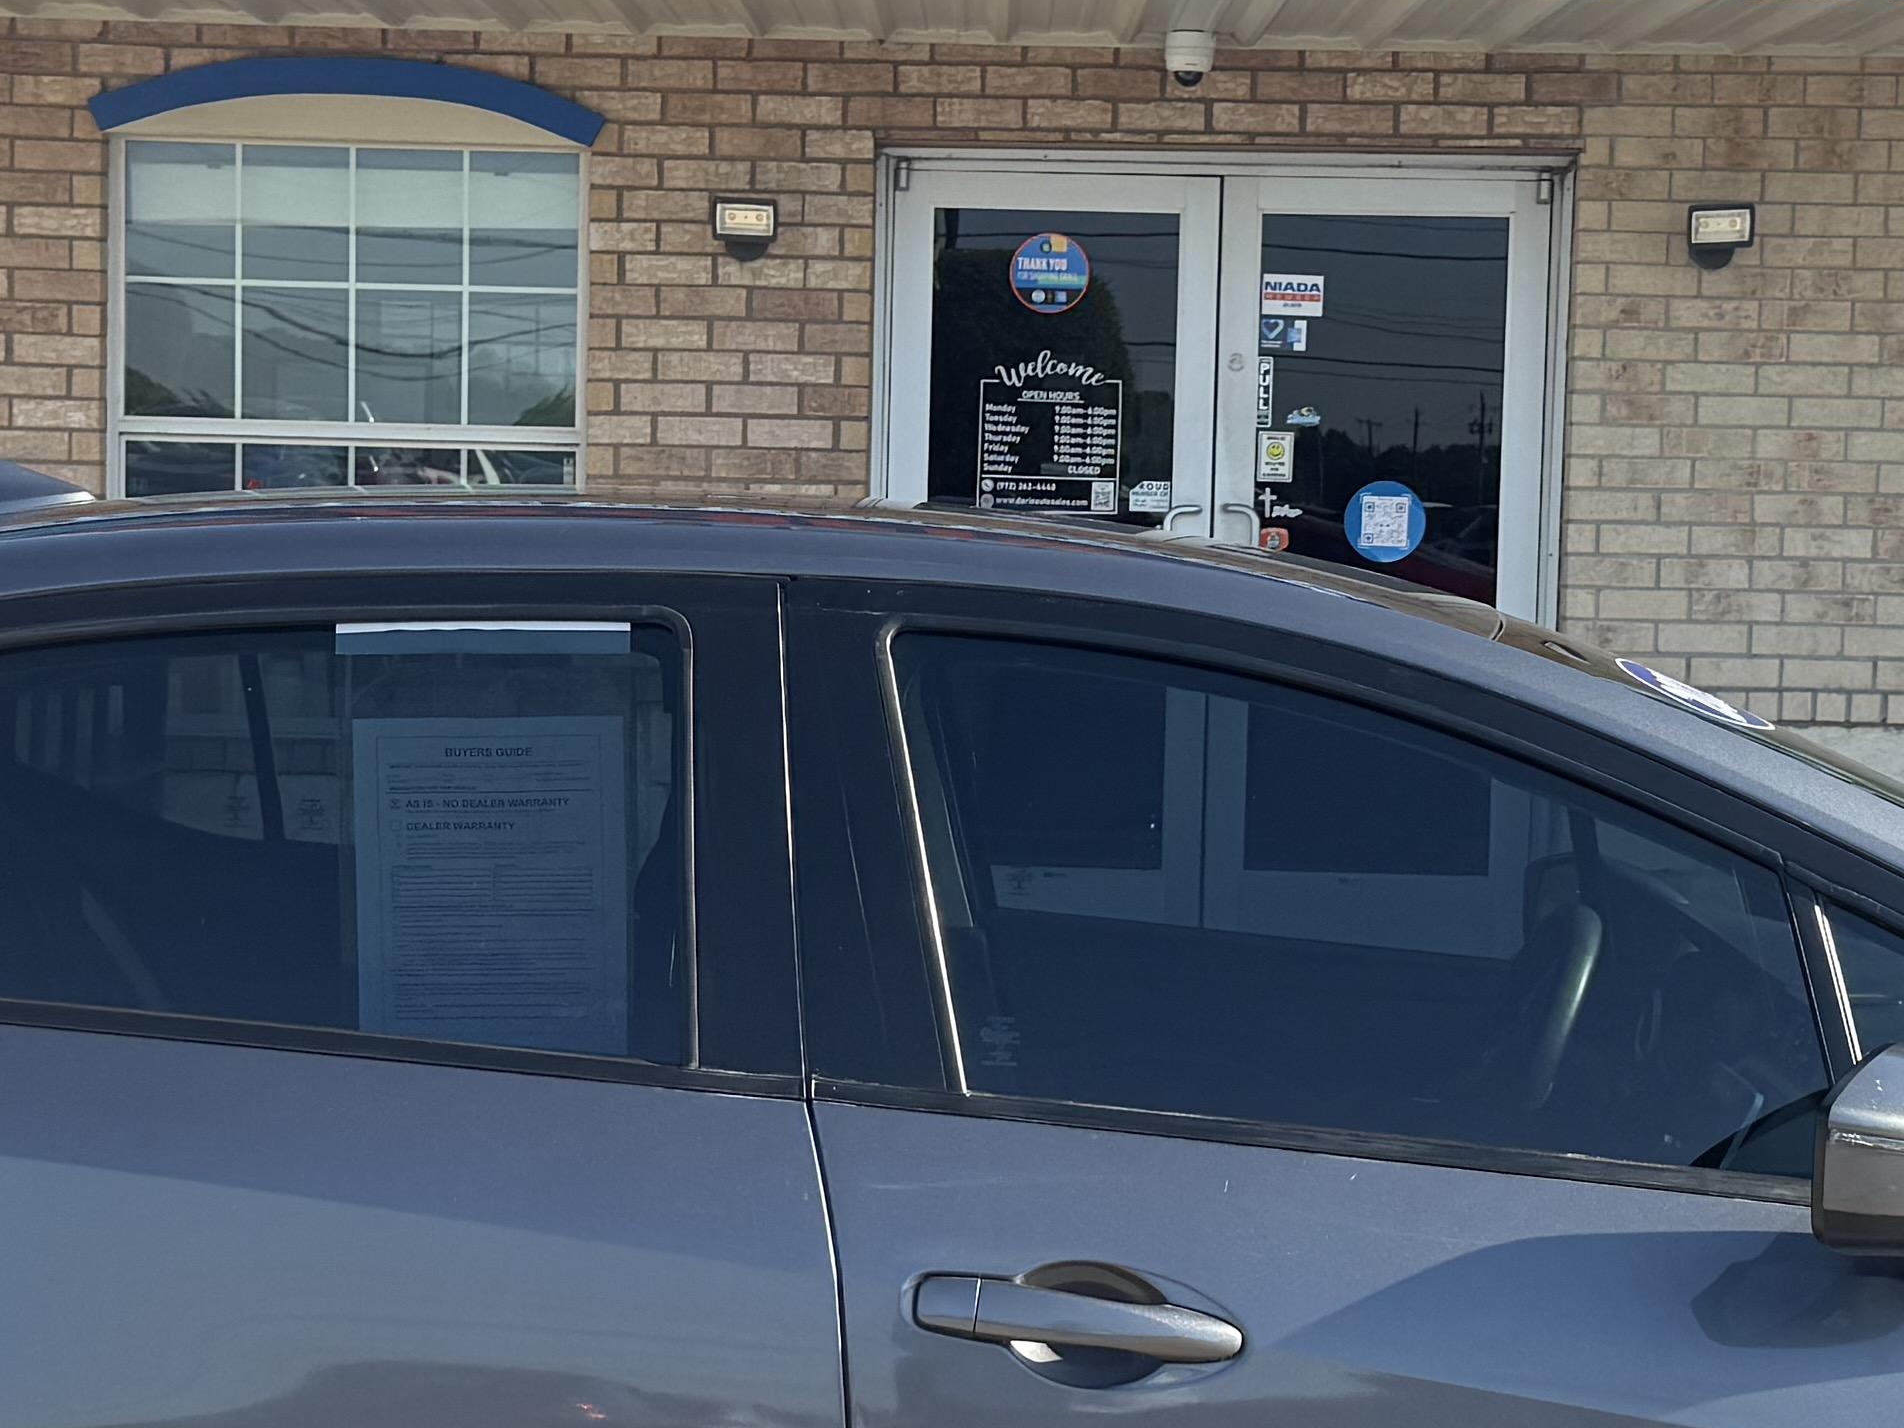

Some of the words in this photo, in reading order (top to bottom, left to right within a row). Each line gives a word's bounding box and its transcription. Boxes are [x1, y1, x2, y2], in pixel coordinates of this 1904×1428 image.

[1017, 257, 1047, 270] THANK
[1049, 258, 1068, 271] YOU
[1264, 281, 1321, 292] NIADA
[994, 350, 1106, 387] Welcome
[1258, 362, 1270, 410] PULL
[1022, 390, 1047, 400] OPEN
[1048, 391, 1080, 401] HOURS
[985, 404, 1016, 414] Monday
[985, 413, 1017, 424] Tuesday
[984, 423, 1030, 434] Wednesday
[984, 433, 1021, 444] Thursday
[984, 443, 1009, 453] Friday
[983, 453, 1019, 464] Saturday
[983, 463, 1013, 474] Sunday
[1067, 465, 1101, 475] CLOSED
[445, 747, 492, 757] BUYERS
[496, 747, 533, 757] GUIDE
[406, 799, 420, 808] AS
[423, 799, 434, 808] IS
[442, 799, 459, 808] NO
[462, 798, 506, 808] DEALER
[507, 797, 570, 808] WARRANTY
[406, 822, 451, 832] DEALER
[452, 821, 515, 831] WARRANTY
